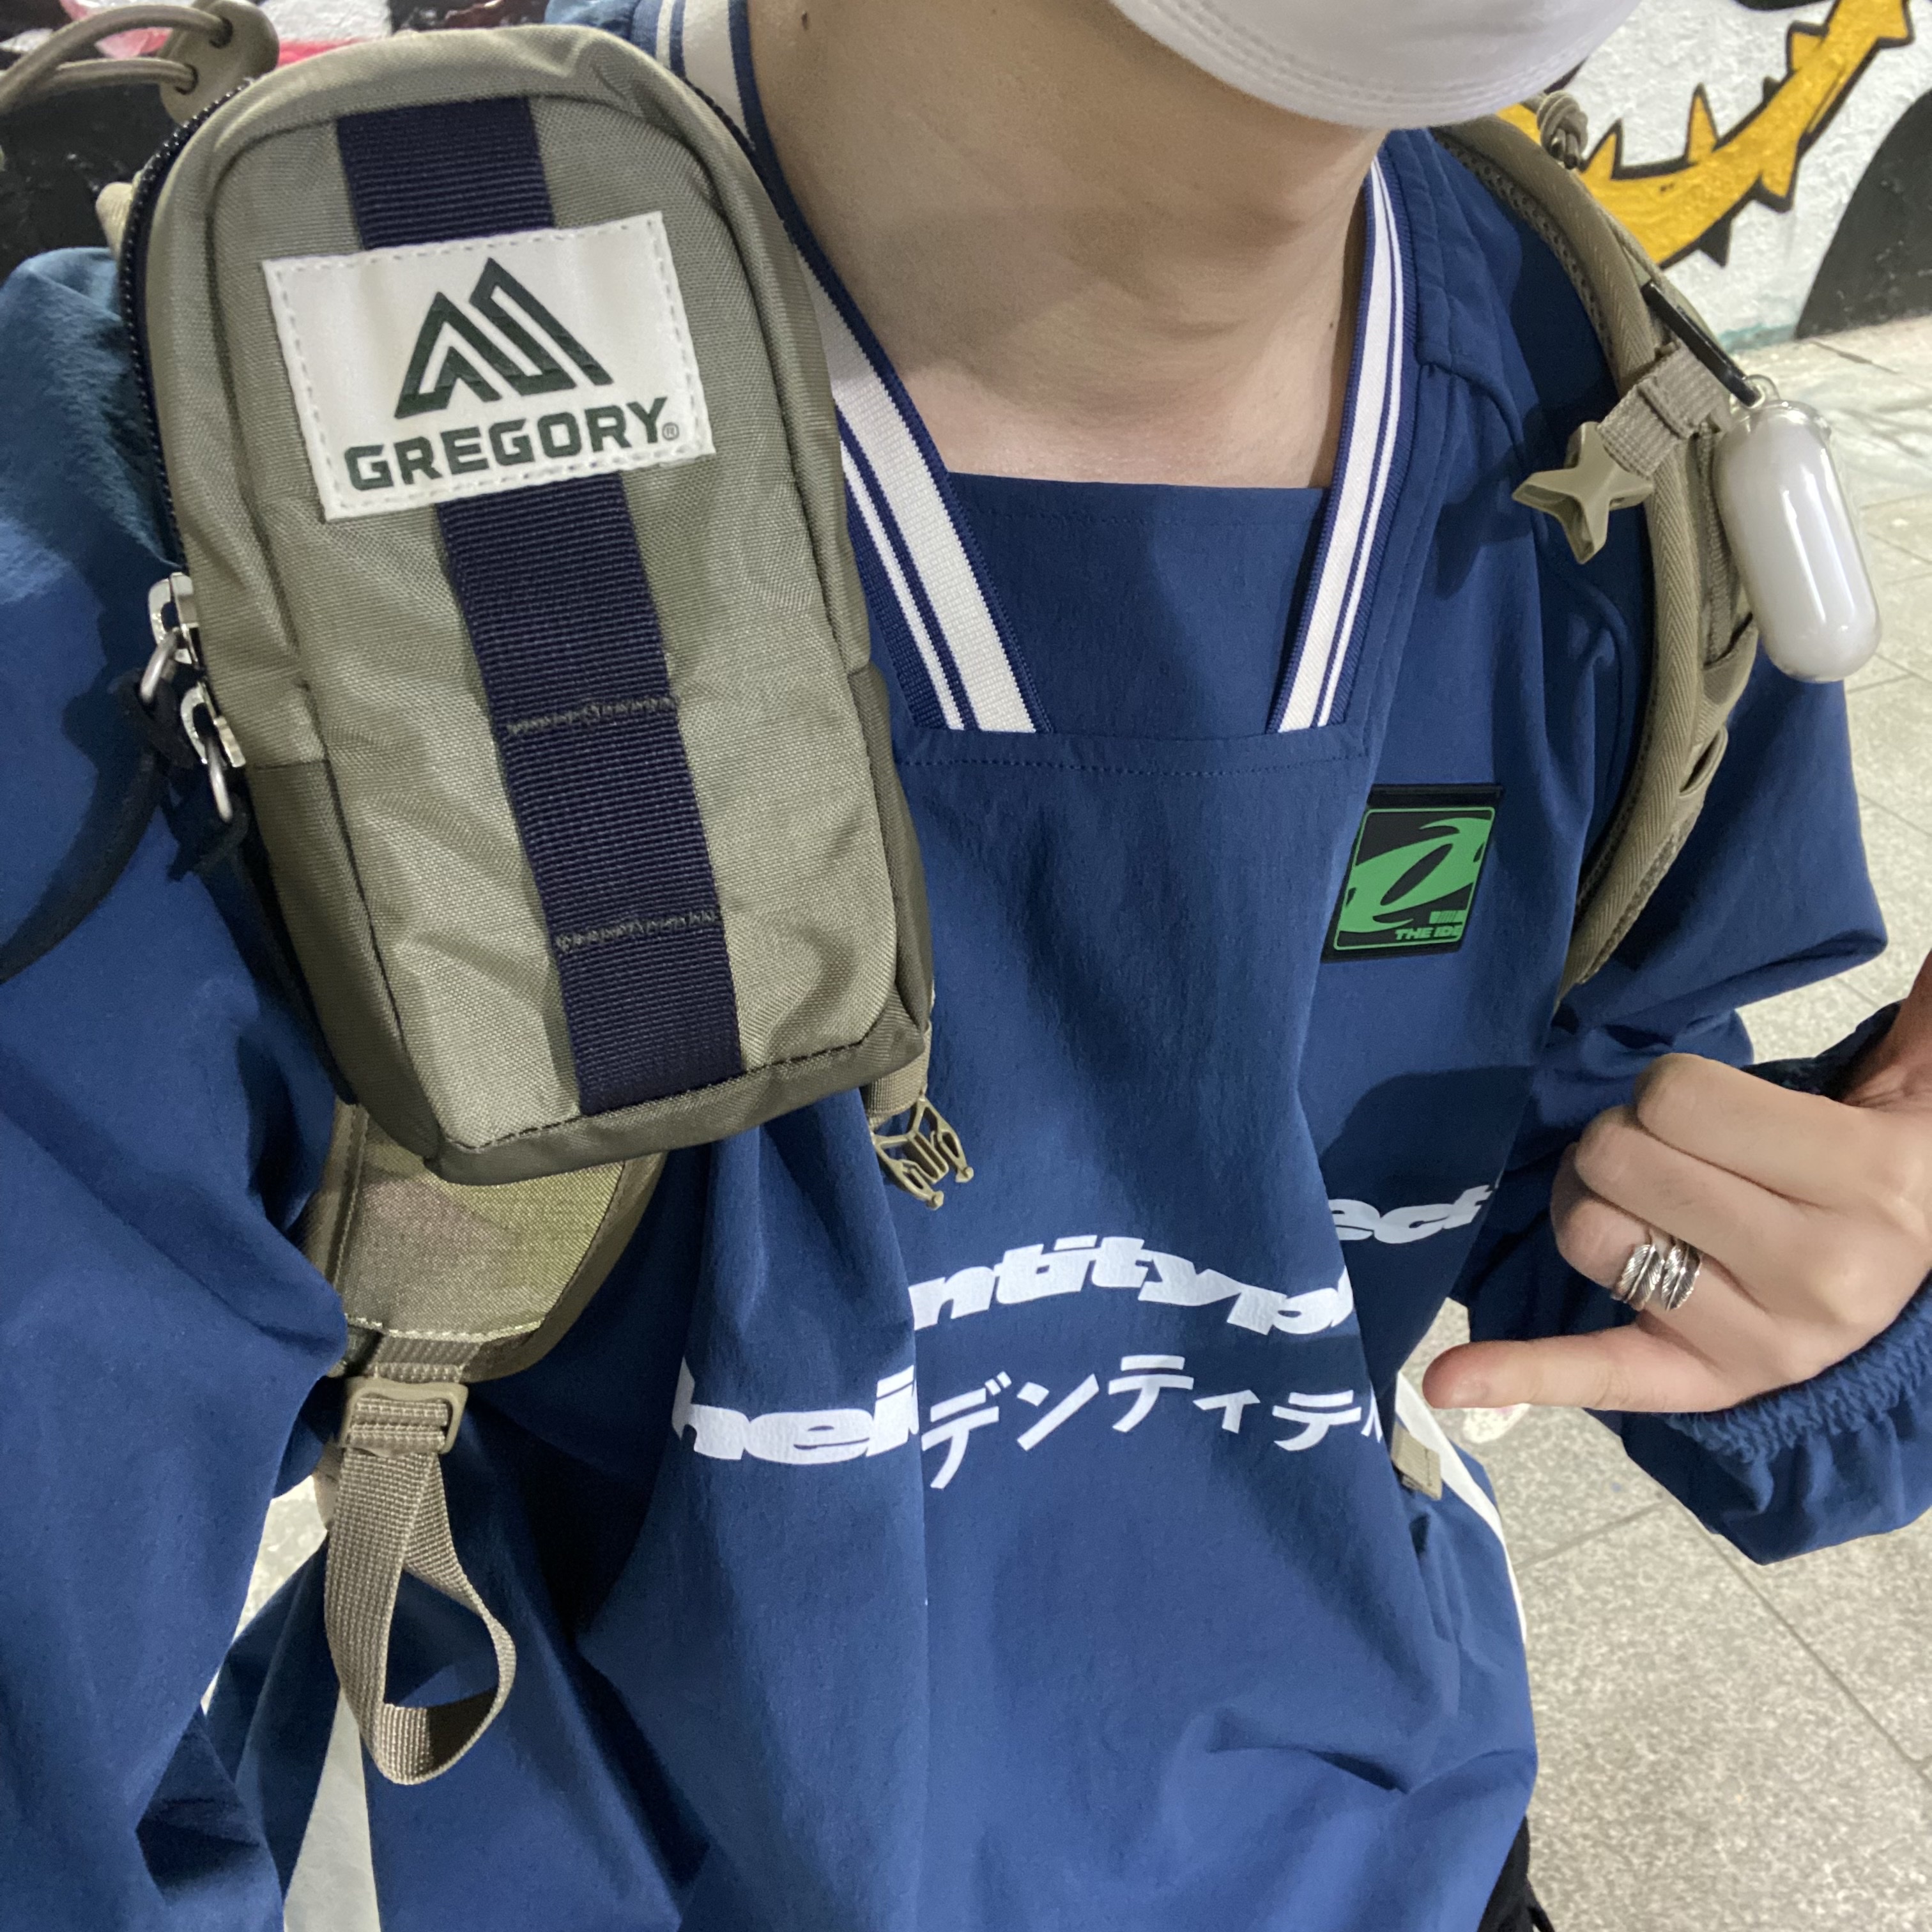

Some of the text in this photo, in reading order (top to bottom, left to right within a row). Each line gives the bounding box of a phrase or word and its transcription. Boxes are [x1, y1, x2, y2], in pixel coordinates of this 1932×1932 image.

[1395, 927, 1434, 940] THE
[908, 1235, 1354, 1335] ntityp
[671, 1355, 919, 1465] hei
